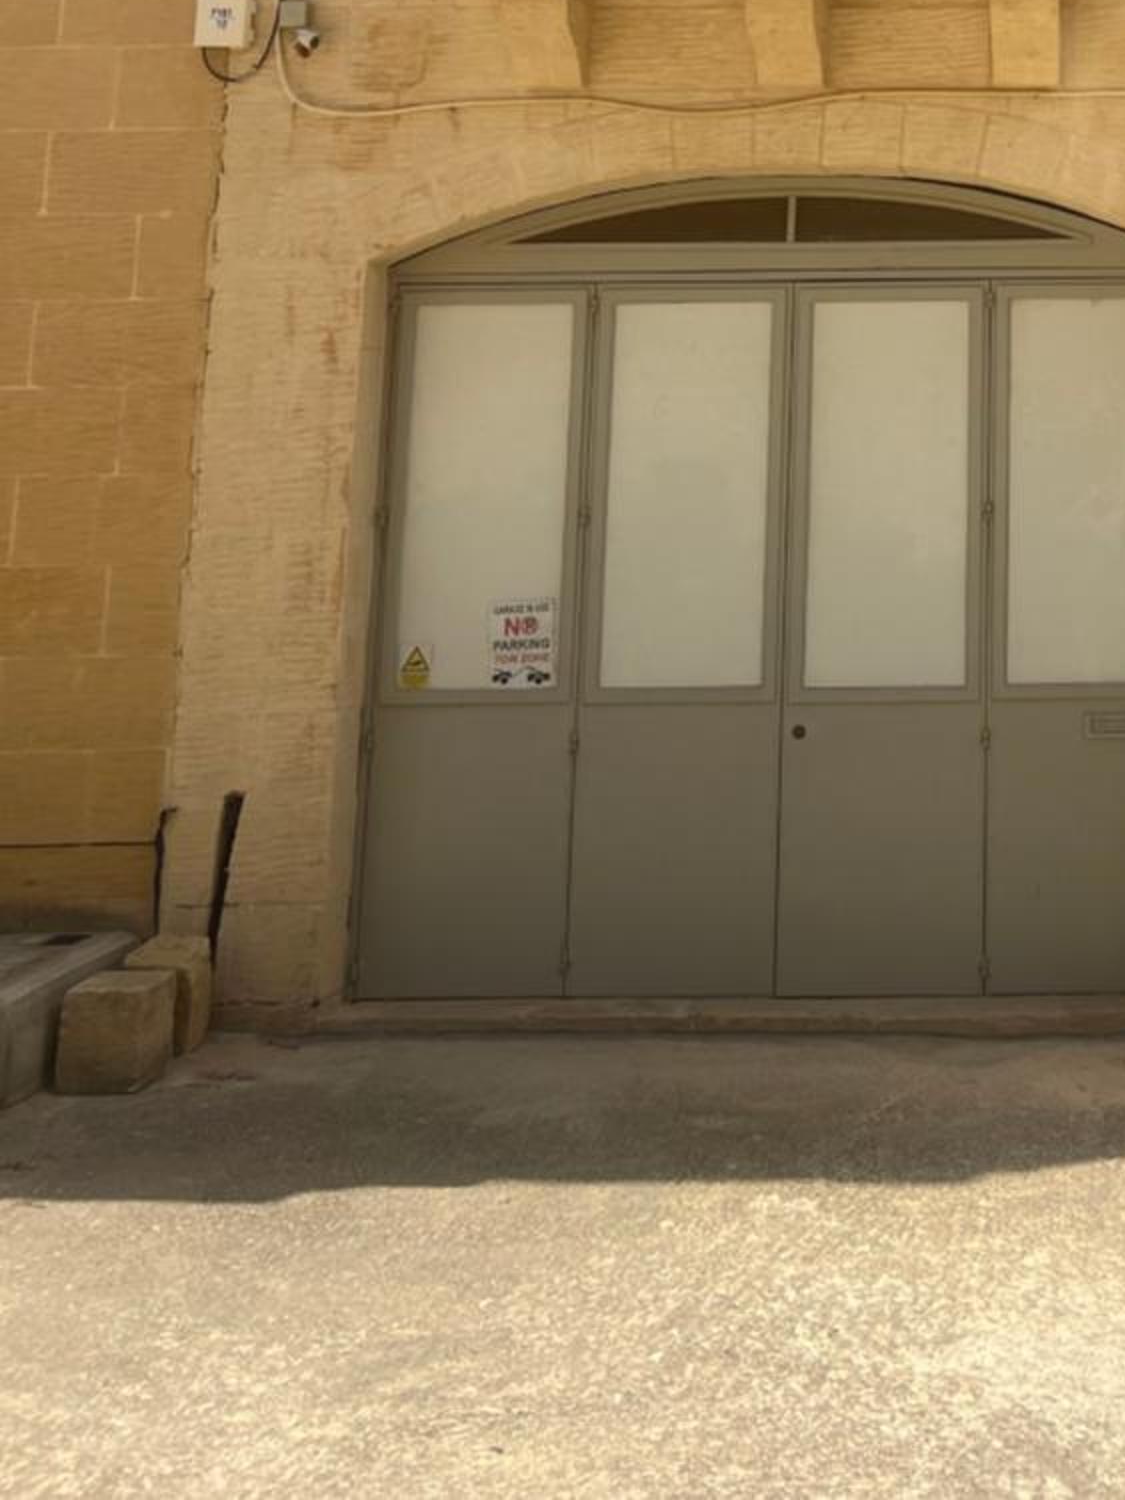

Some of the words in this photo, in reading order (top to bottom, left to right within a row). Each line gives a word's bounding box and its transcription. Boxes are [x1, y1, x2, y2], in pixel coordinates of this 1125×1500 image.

[504, 617, 538, 636] NO
[493, 638, 550, 651] PARKING
[495, 654, 518, 664] TOW
[521, 652, 549, 663] ZONE
